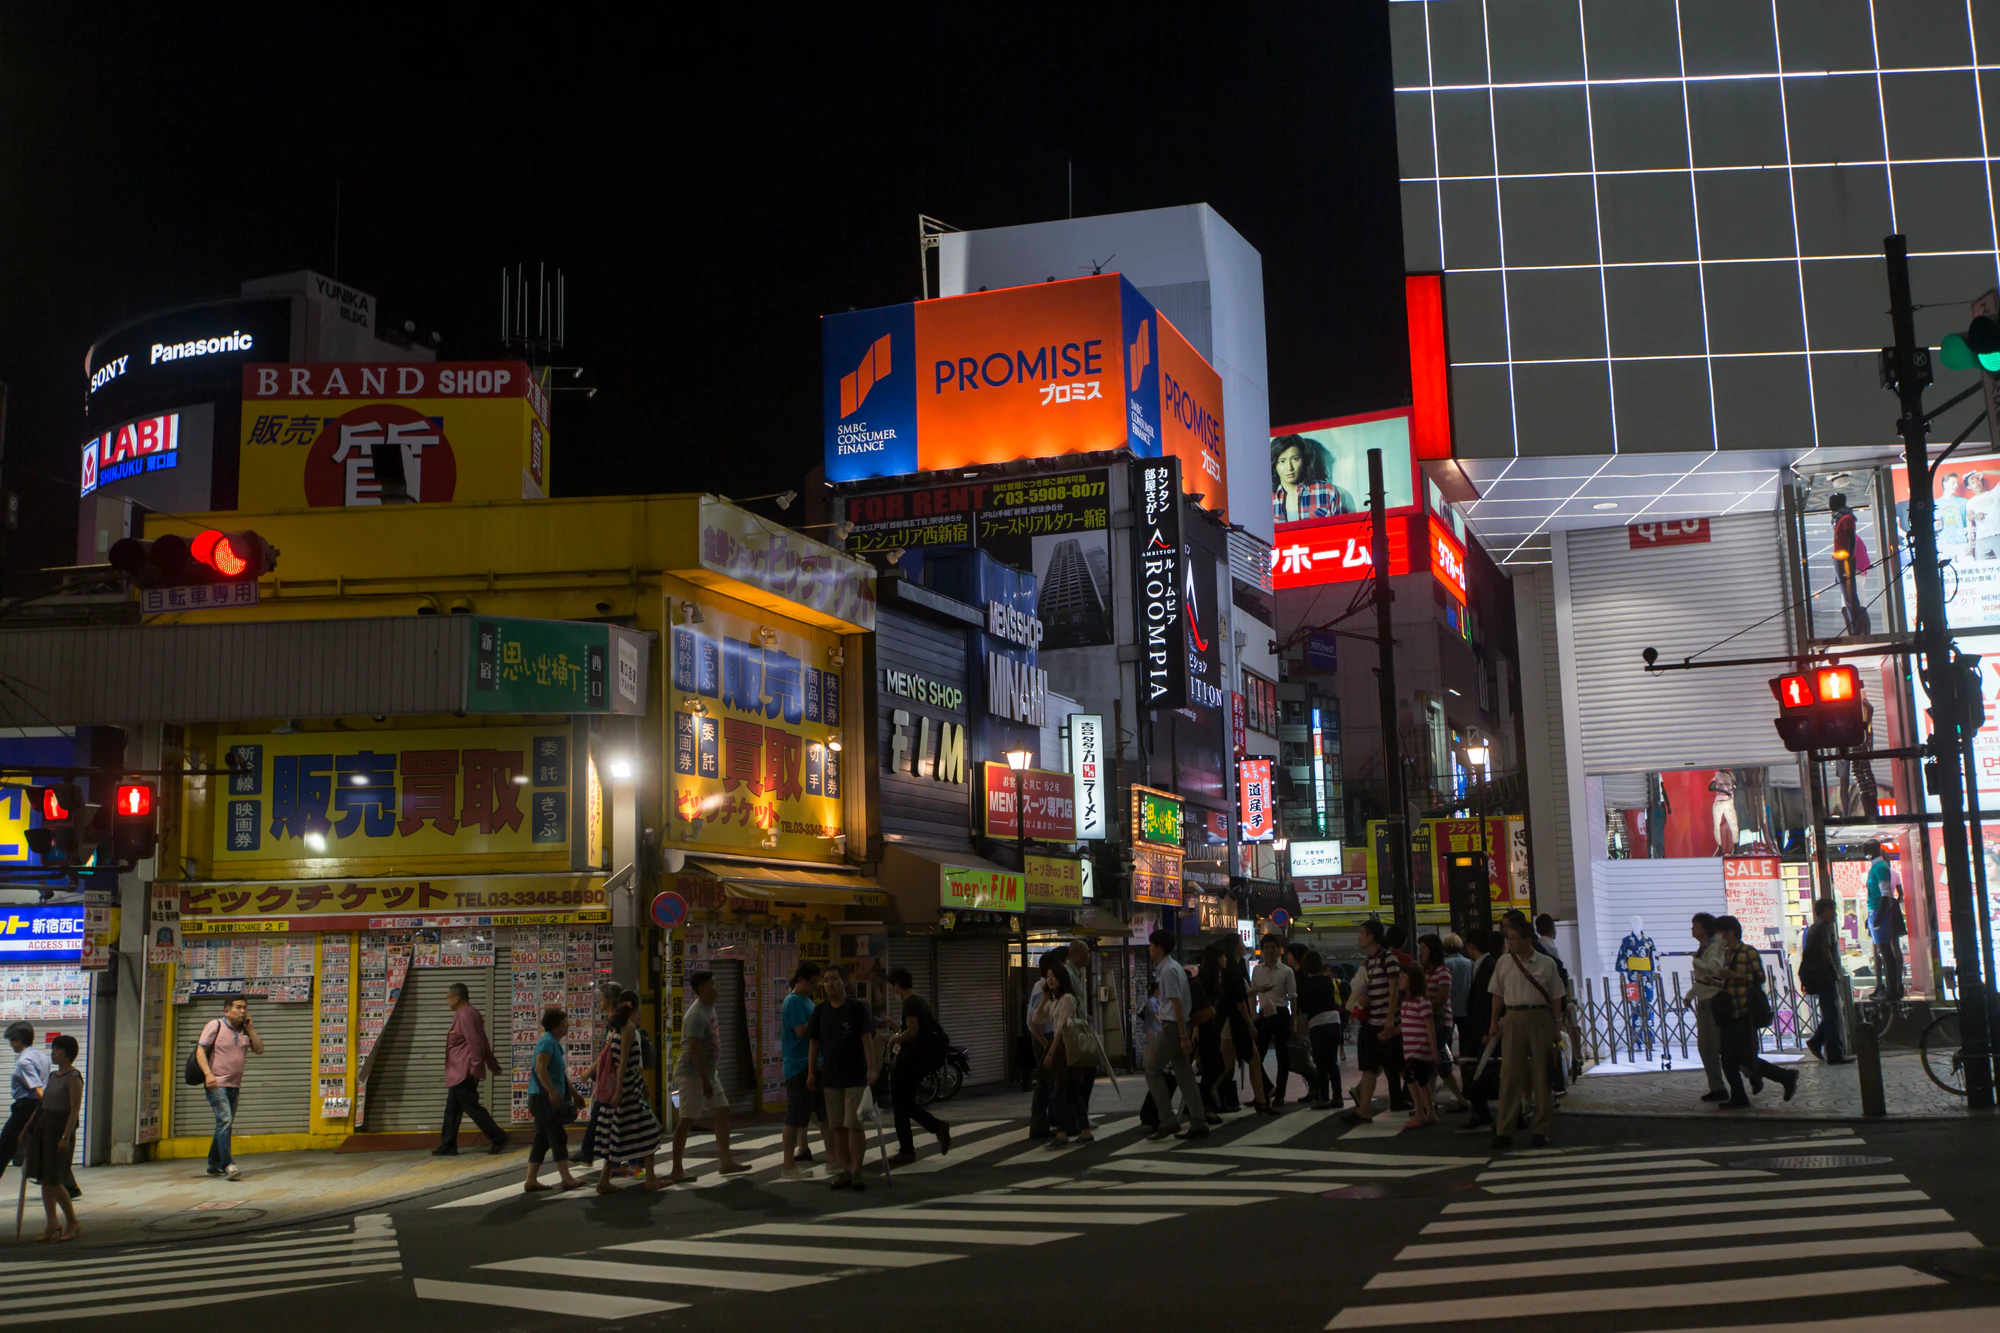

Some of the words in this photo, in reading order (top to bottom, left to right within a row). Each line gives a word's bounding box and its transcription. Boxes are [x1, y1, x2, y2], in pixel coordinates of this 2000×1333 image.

[316, 279, 370, 311] YUNIKA
[151, 331, 253, 365] Panasonic
[91, 355, 129, 394] SONY
[257, 368, 425, 395] BRAND
[438, 369, 511, 394] SHOP
[935, 339, 1102, 395] PROMISE
[1039, 381, 1103, 406] プロミス
[246, 415, 320, 446] 販売
[837, 422, 867, 434] SMBC
[1164, 372, 1220, 457] PROMISE
[100, 413, 180, 469] LABI
[837, 429, 897, 445] CONSUMER
[837, 440, 885, 455] FINANCE
[100, 457, 144, 487] SHINJUKU
[1201, 449, 1222, 483] プロミス
[851, 494, 905, 522] FOR
[913, 485, 988, 516] RENT
[1005, 482, 1106, 506] 03-5908-8077
[1144, 468, 1157, 526] 部屋さがし
[1157, 467, 1170, 513] カンタン
[849, 522, 968, 551] コンシェリア西新宿
[980, 508, 1106, 538] ファーストリアルタワー新宿
[1142, 549, 1176, 557] AMBITION
[1438, 538, 1466, 591] タマホーム
[147, 582, 254, 609] 自転車専用
[1163, 558, 1177, 626] ルームピア
[1146, 560, 1168, 699] ROOMPIA
[480, 633, 493, 680] 新宿
[502, 641, 582, 692] 思い出横丁
[678, 632, 693, 688] 新幹線
[702, 643, 715, 688] きっぷ
[592, 655, 602, 697] 西口
[722, 636, 804, 725] 販売
[807, 669, 819, 718] 商品券
[885, 668, 927, 702] MEN'S
[928, 681, 963, 710] SHOP
[988, 651, 1049, 729] MINAMI
[826, 674, 838, 723] 株主券
[678, 714, 693, 770] 映画券
[702, 722, 715, 771] 委託
[722, 717, 804, 802] 買取
[891, 709, 964, 784] FIM
[1081, 722, 1096, 763] 喜多方
[540, 740, 558, 782] 委託
[1003, 776, 1042, 791] お客と共に
[1044, 781, 1060, 794] 62年
[539, 796, 558, 837] きっぷ
[674, 790, 780, 829] ビックチケット
[989, 791, 1019, 813] MEN'
[1022, 795, 1073, 819] スーツ専門店
[1248, 782, 1265, 828] 道産子
[234, 802, 254, 849] 映画券
[1449, 834, 1495, 855] 買取
[1305, 878, 1367, 891] モバワン
[1726, 861, 1773, 877] SALE
[180, 881, 449, 914] ビックチケット
[951, 878, 987, 899] men's
[991, 874, 1017, 902] FIM
[32, 918, 83, 934] 新宿西口
[235, 923, 261, 932] EXCHANGE
[519, 915, 547, 923] EXCHANGE
[568, 931, 592, 941] テレカ
[1210, 914, 1238, 929] ROOMPIA
[28, 940, 63, 949] ACCESS
[800, 942, 829, 957] 外国送金
[513, 1011, 537, 1019] ロイヤル
